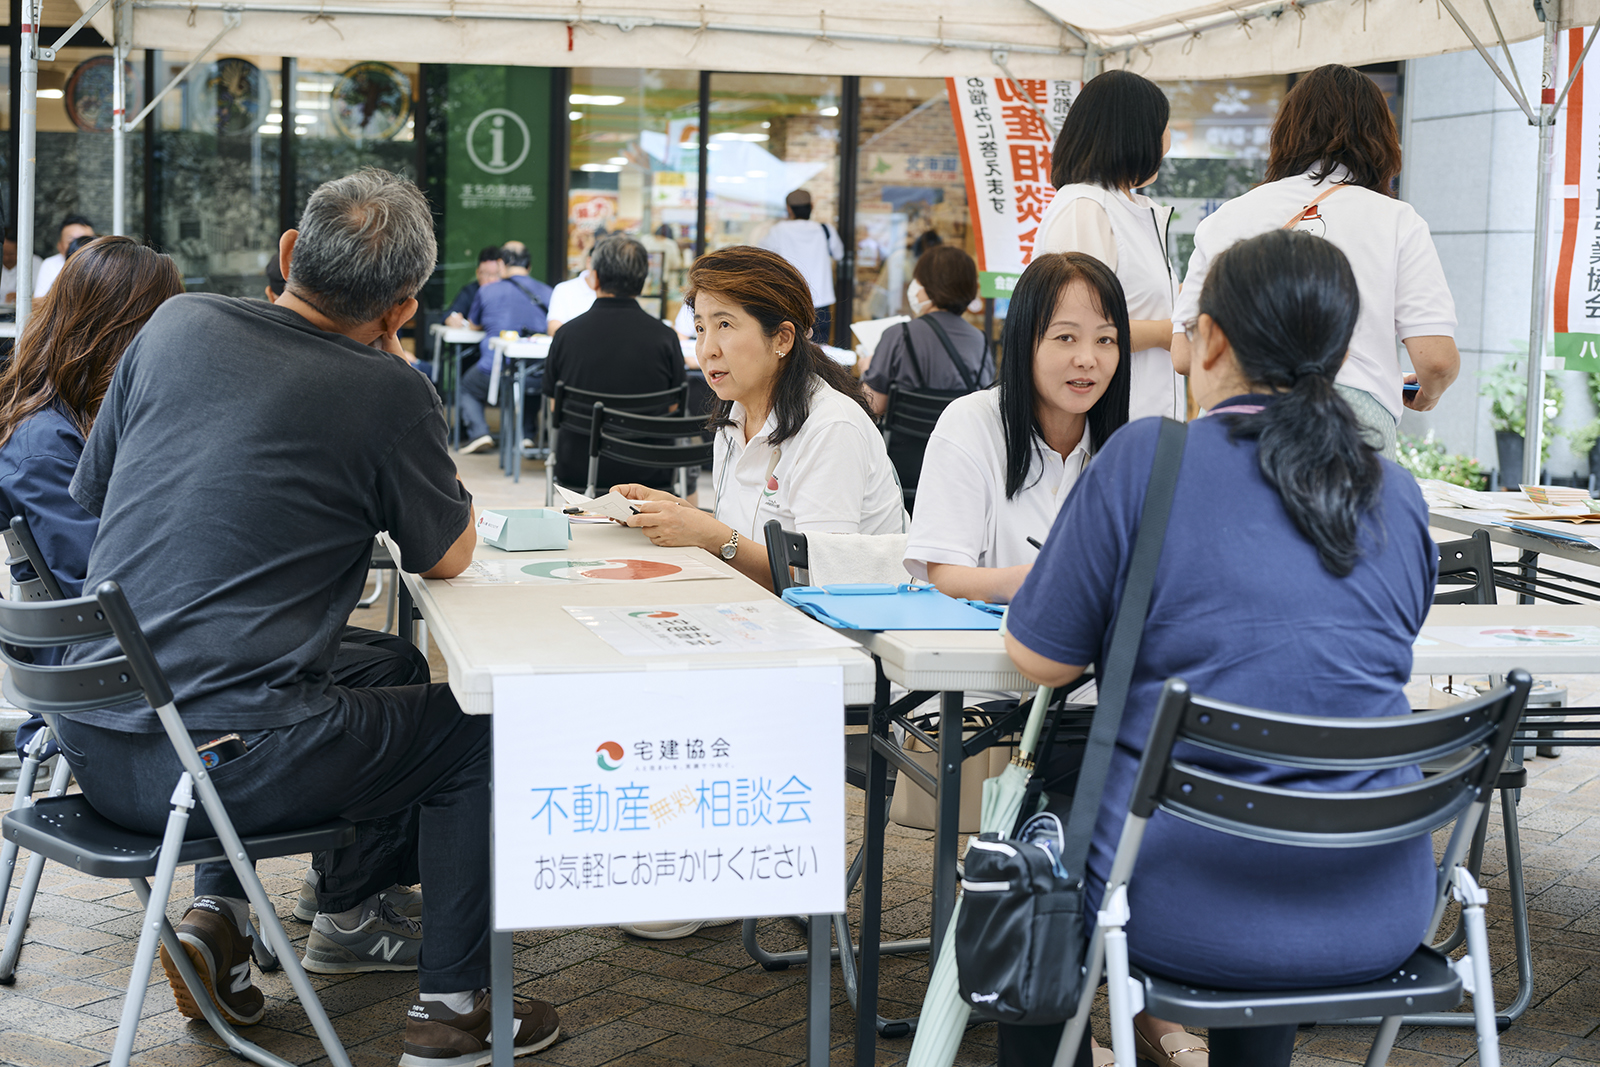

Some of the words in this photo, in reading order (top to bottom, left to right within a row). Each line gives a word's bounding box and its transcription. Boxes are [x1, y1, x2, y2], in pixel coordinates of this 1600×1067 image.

[633, 737, 731, 761] 宅建協会
[534, 844, 818, 890] お気軽にお声かけください
[407, 1009, 430, 1019] balance
